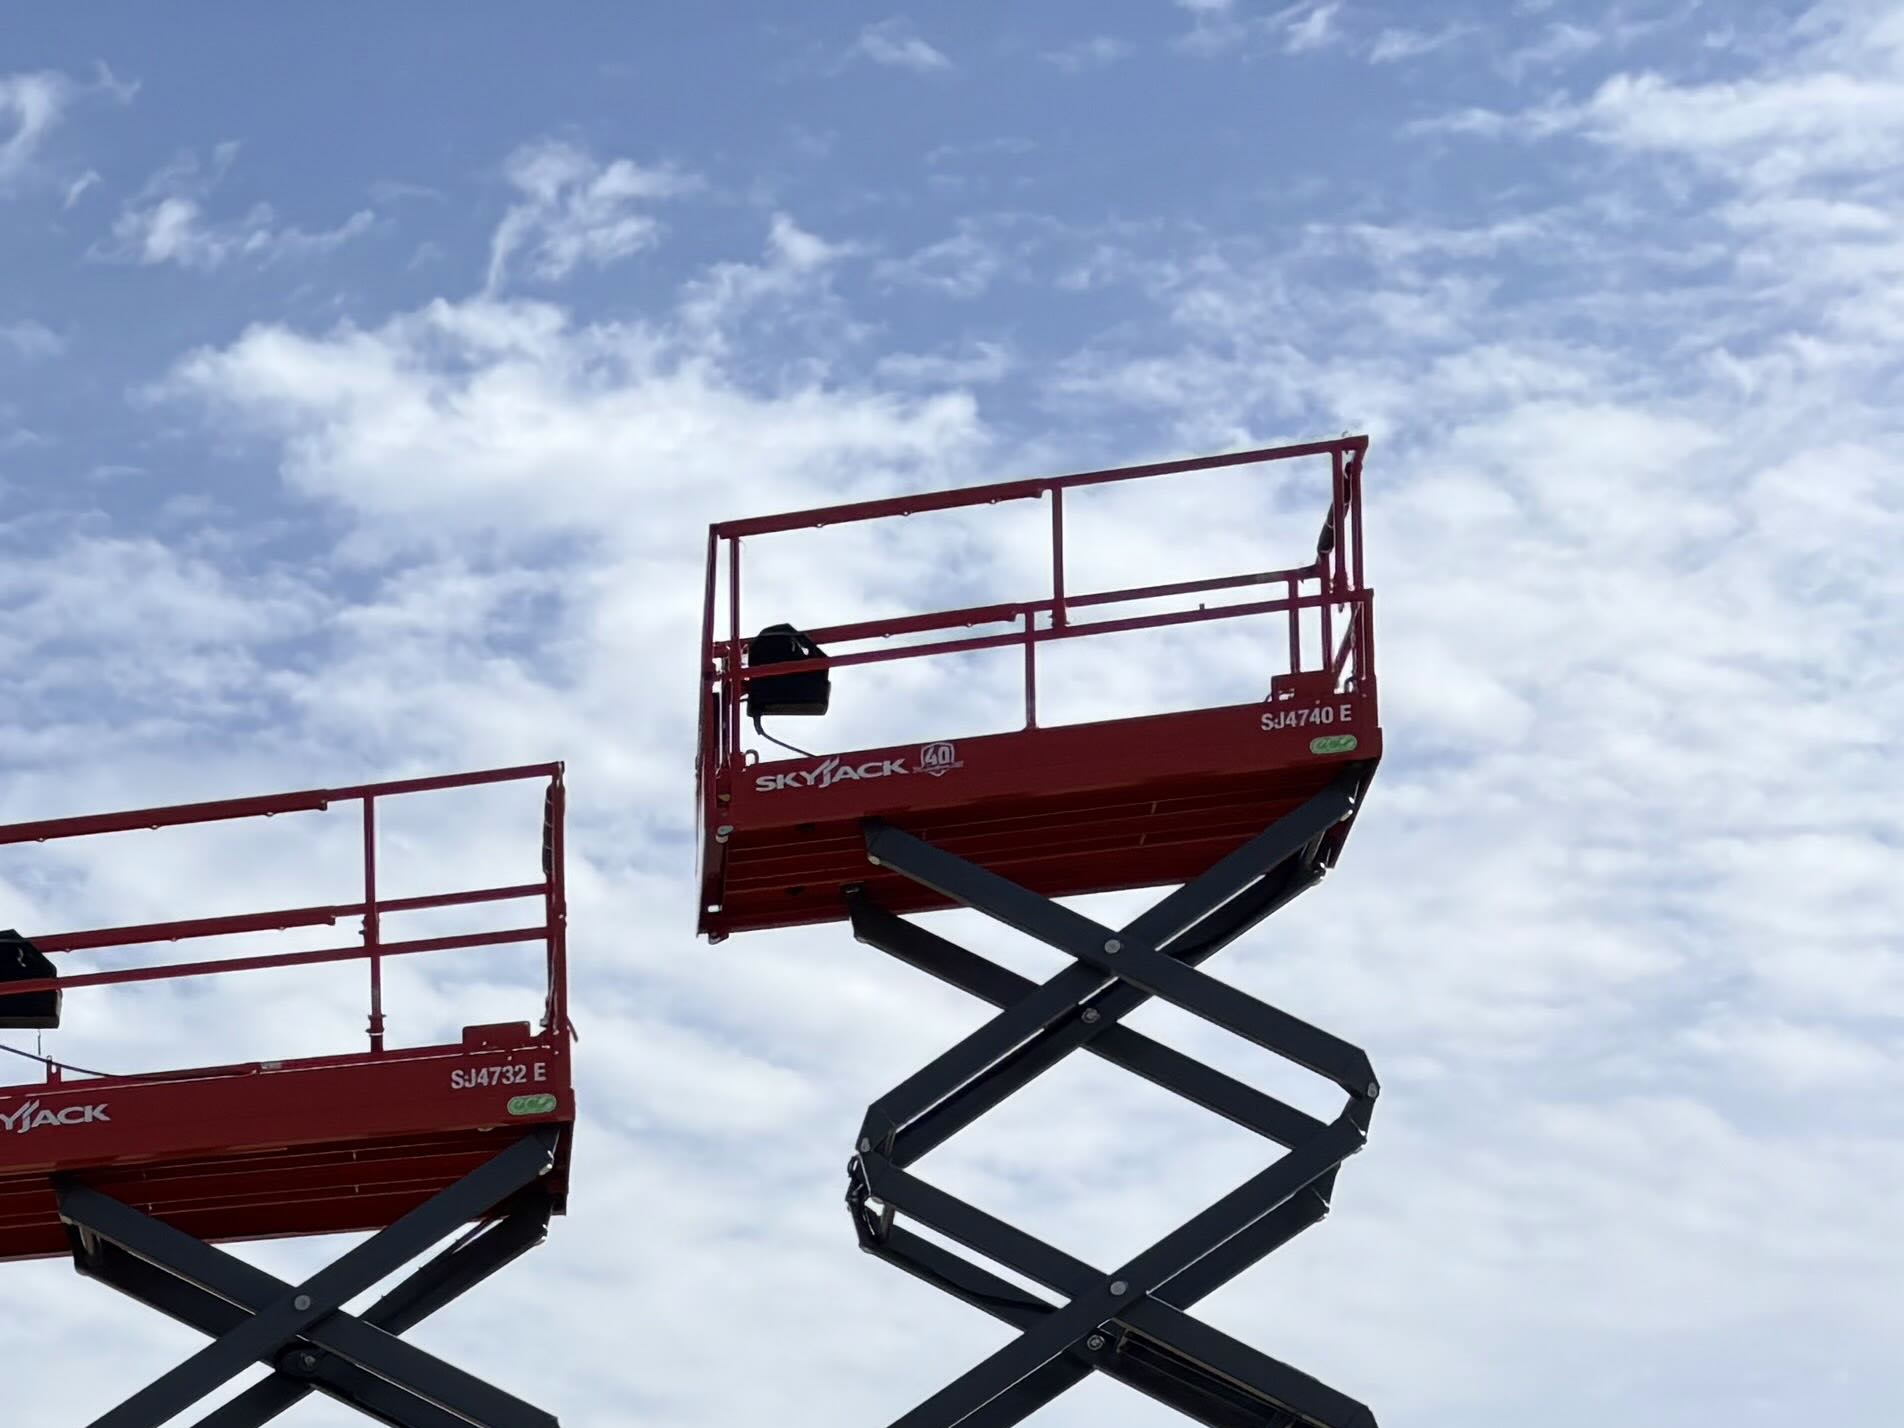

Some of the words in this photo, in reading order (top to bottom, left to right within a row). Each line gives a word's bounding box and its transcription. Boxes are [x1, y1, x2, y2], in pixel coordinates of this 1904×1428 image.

[1261, 706, 1334, 731] SJ4740
[1339, 704, 1352, 721] E
[924, 746, 951, 766] 40
[755, 755, 910, 792] SKYJACK
[451, 1064, 527, 1089] SJ4732
[534, 1062, 547, 1081] E
